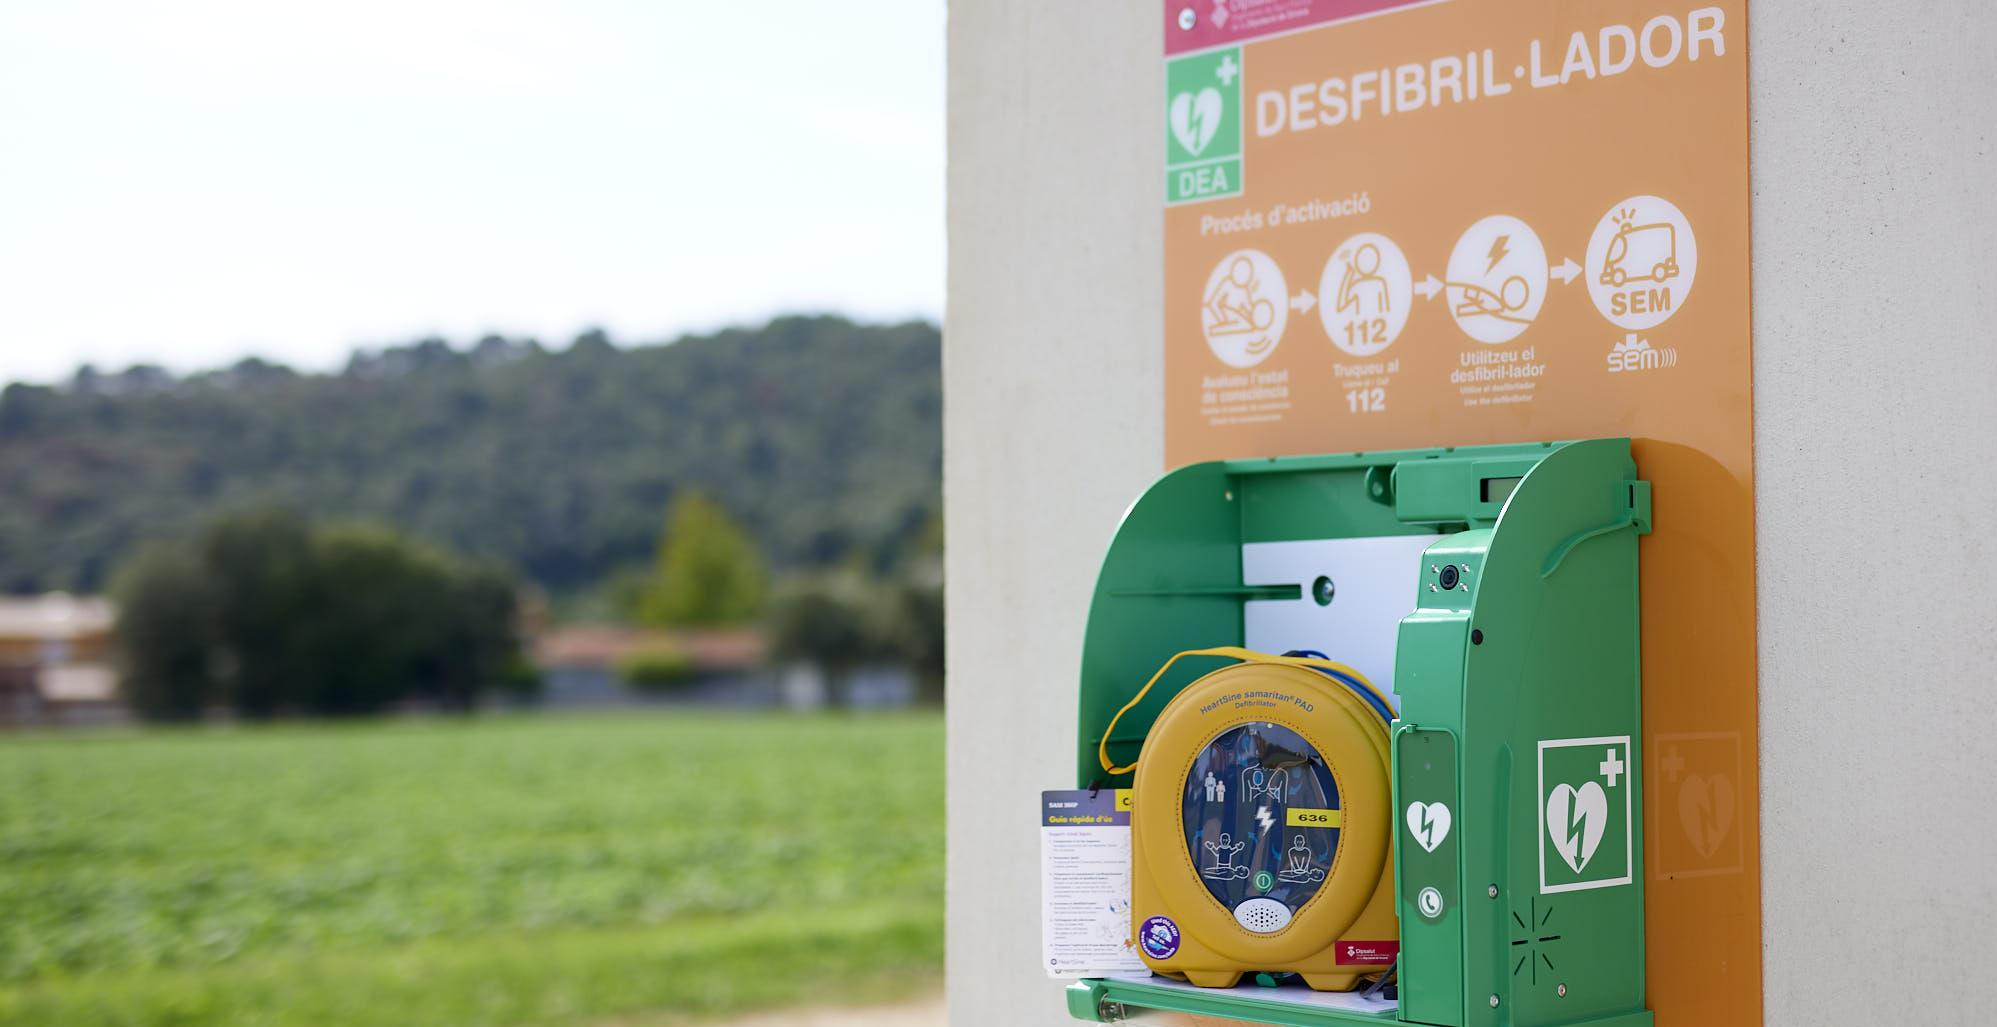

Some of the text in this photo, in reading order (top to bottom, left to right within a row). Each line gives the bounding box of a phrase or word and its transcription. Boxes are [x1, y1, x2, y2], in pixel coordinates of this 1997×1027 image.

[1256, 6, 1726, 138] DESFIBRIL·LADOR
[1179, 166, 1228, 198] DEA
[1200, 210, 1264, 236] Procés
[1611, 287, 1671, 317] SEM
[1344, 318, 1388, 346] 112
[1460, 345, 1535, 367] Utilitzeu el
[1607, 348, 1659, 372] sem
[1345, 387, 1386, 414] 112
[1200, 692, 1242, 714] HeartSine
[1294, 697, 1314, 713] PAD
[1298, 814, 1328, 822] 636
